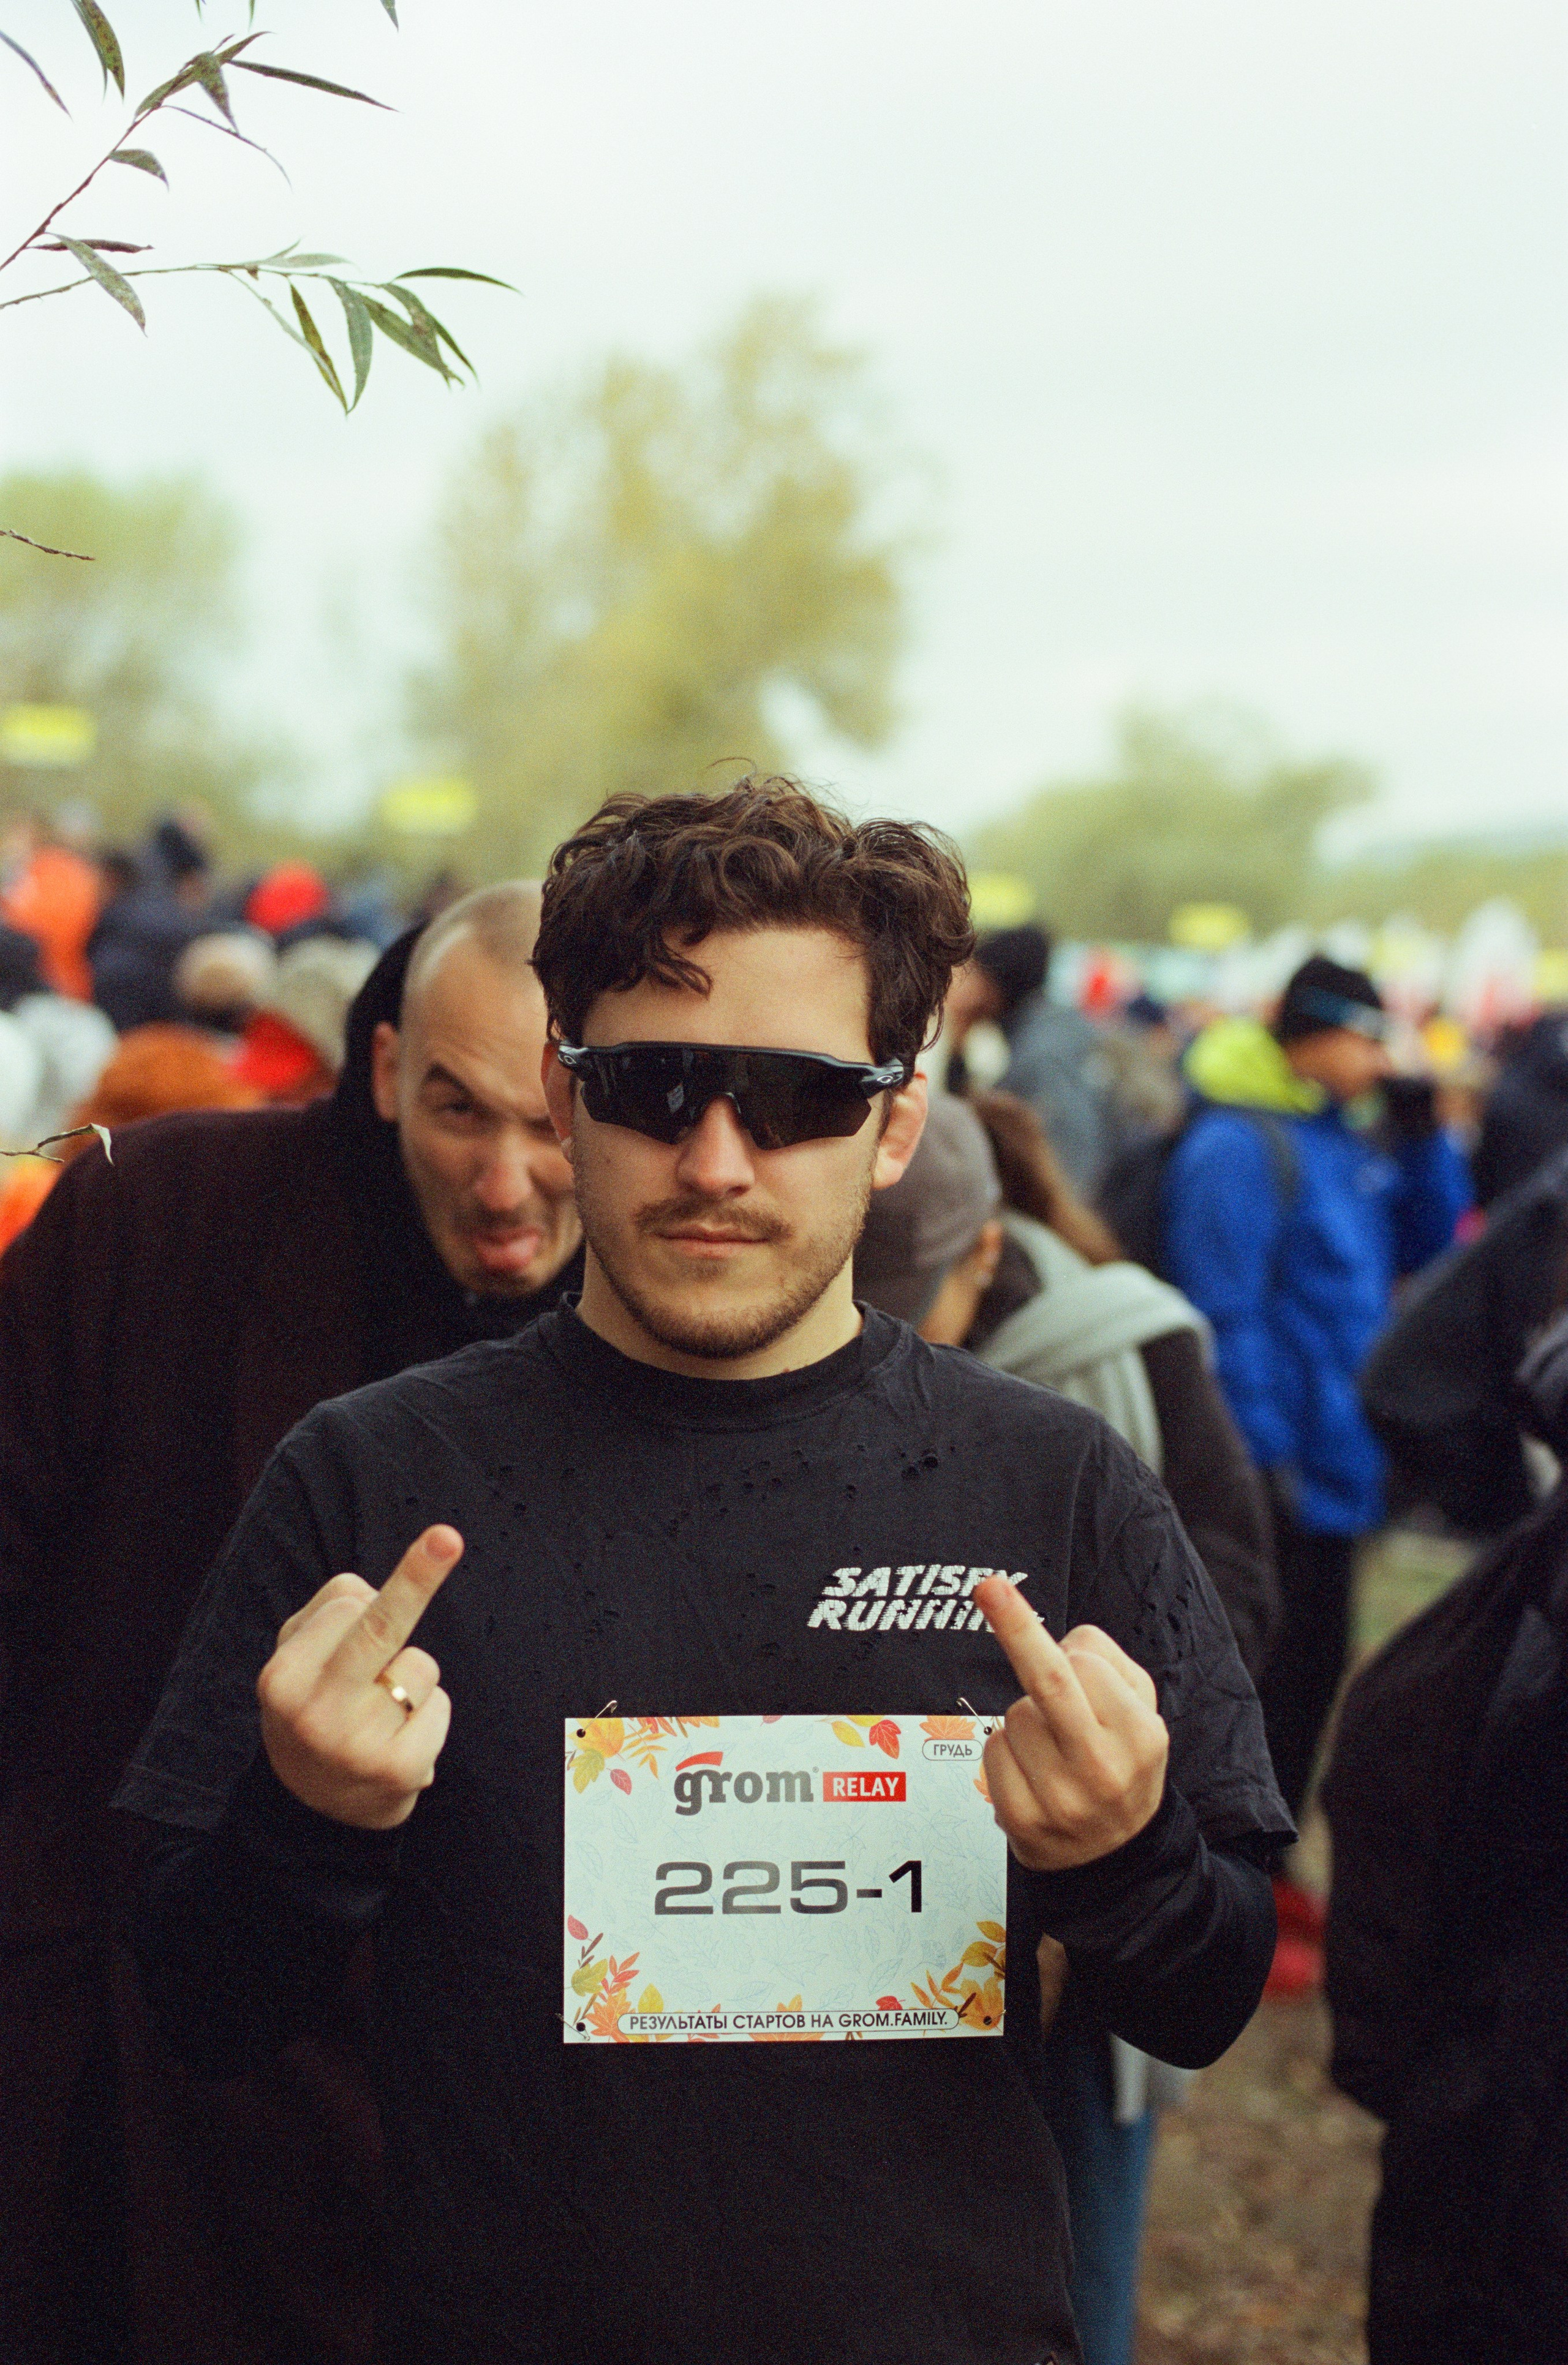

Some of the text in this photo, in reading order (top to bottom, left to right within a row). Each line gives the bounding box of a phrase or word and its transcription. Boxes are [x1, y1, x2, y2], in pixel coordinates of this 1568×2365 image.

[807, 1598, 1045, 1633] RUNNI
[933, 1743, 973, 1758] ГРУДЬ
[832, 1777, 899, 1797] RELAY
[654, 1860, 922, 1915] 225-1
[629, 2011, 948, 2030] РЕЗУЛЬТАТЫ СТАРТОВ НА GROM.FAMILY.
